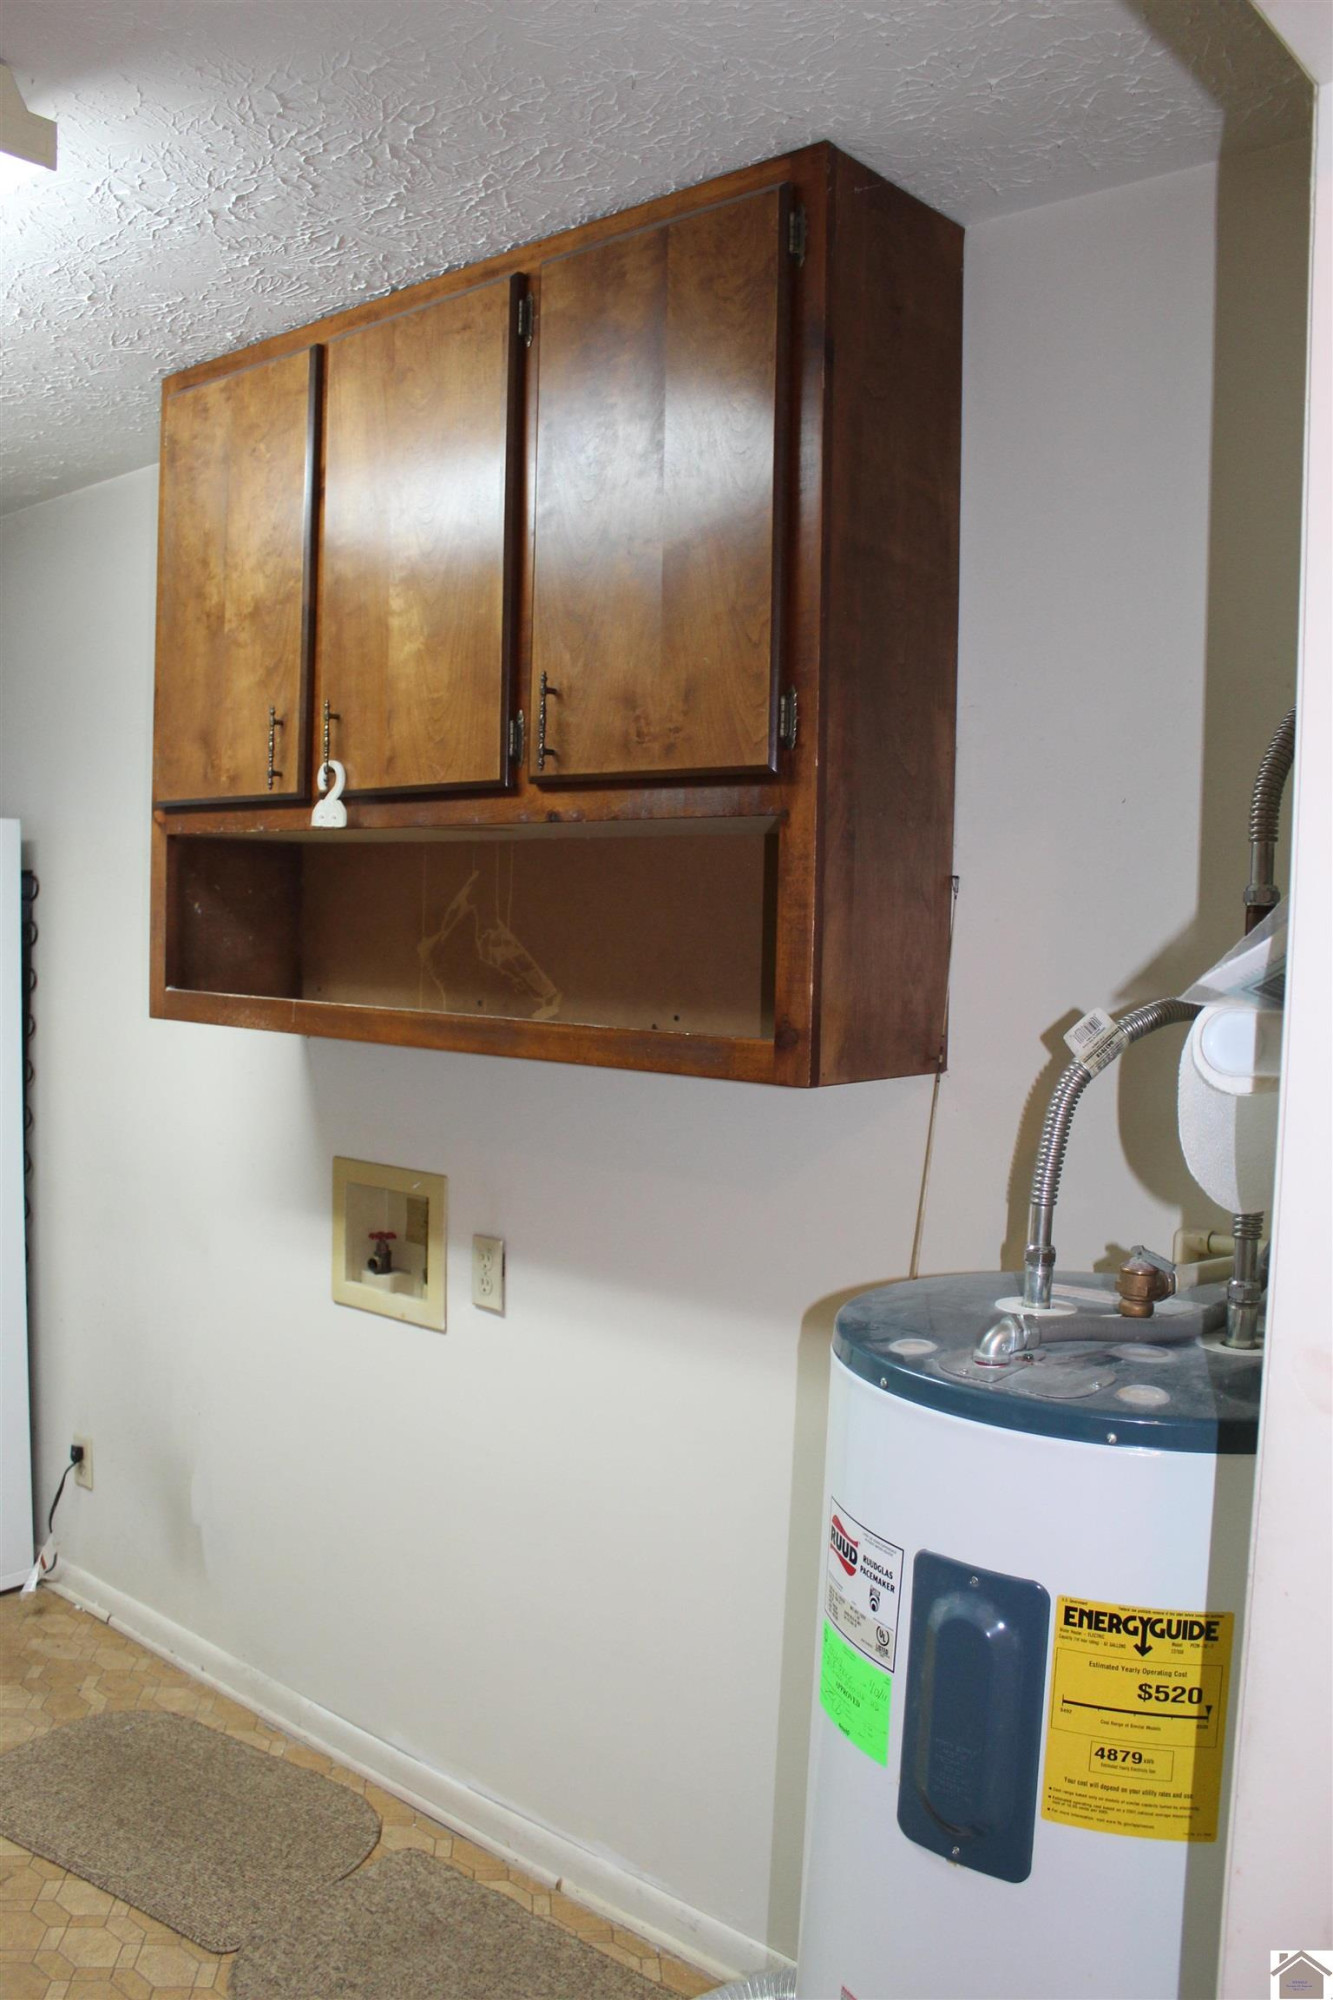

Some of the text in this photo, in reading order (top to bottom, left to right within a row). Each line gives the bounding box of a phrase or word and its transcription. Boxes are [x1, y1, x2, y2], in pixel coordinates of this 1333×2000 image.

[831, 1525, 858, 1565] RUUD
[860, 1565, 895, 1593] PACEMAKER
[863, 1555, 893, 1579] RUUDGLAS
[1064, 1605, 1220, 1642] ENERGYGUIDE
[1088, 1661, 1188, 1678] Estimated Yearly Operating Cost
[1137, 1682, 1203, 1704] $520
[1094, 1746, 1143, 1764] 4879
